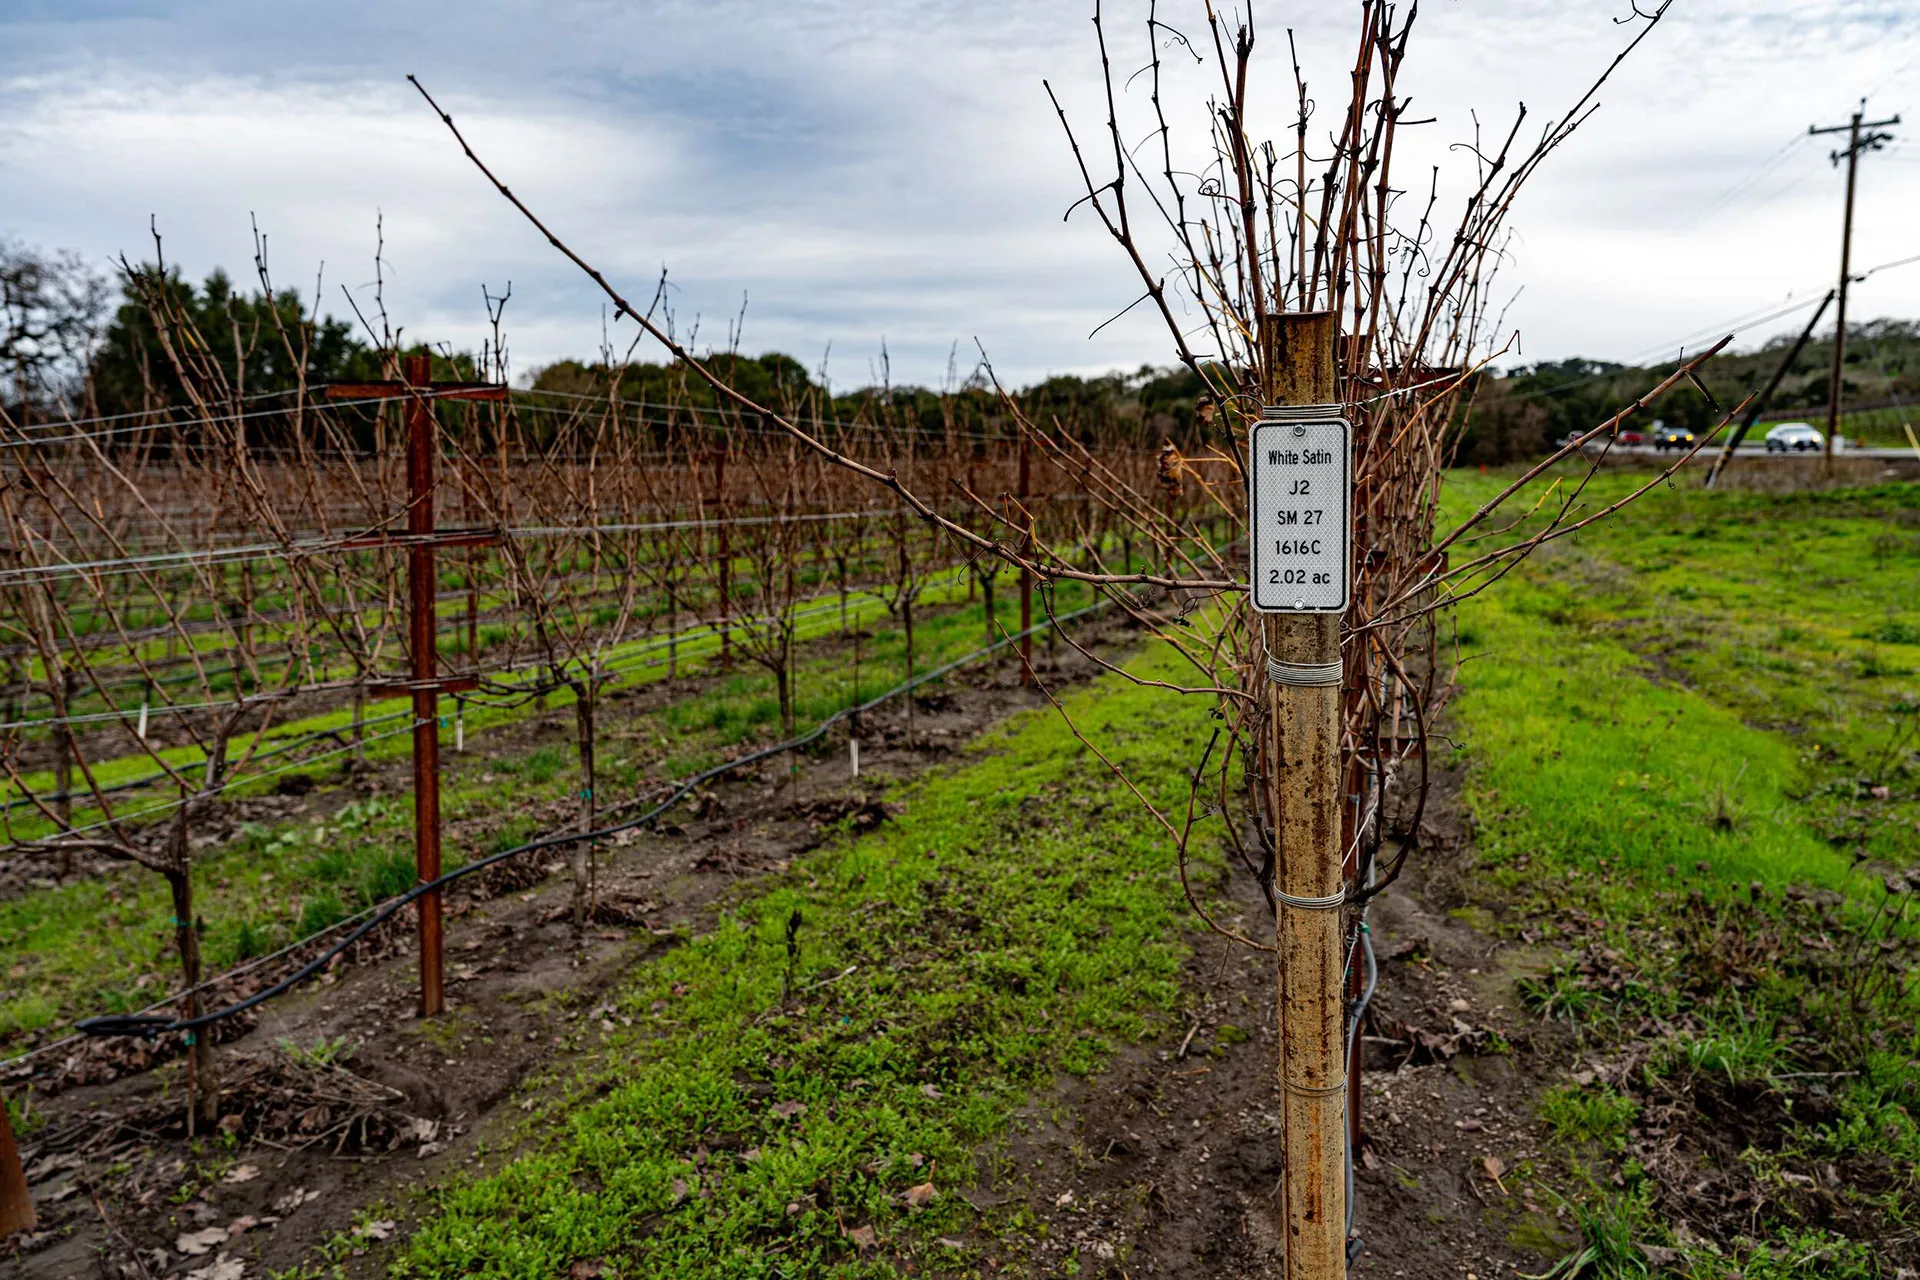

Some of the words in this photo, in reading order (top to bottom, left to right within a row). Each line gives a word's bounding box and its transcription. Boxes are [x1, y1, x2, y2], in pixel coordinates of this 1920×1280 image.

[1268, 449, 1299, 466] White
[1302, 448, 1332, 465] Satin
[1289, 480, 1310, 495] J2
[1277, 510, 1298, 525] SM
[1303, 510, 1323, 525] 27
[1275, 540, 1321, 555] 1616C
[1269, 569, 1306, 584] 2.02
[1312, 572, 1331, 584] ac
